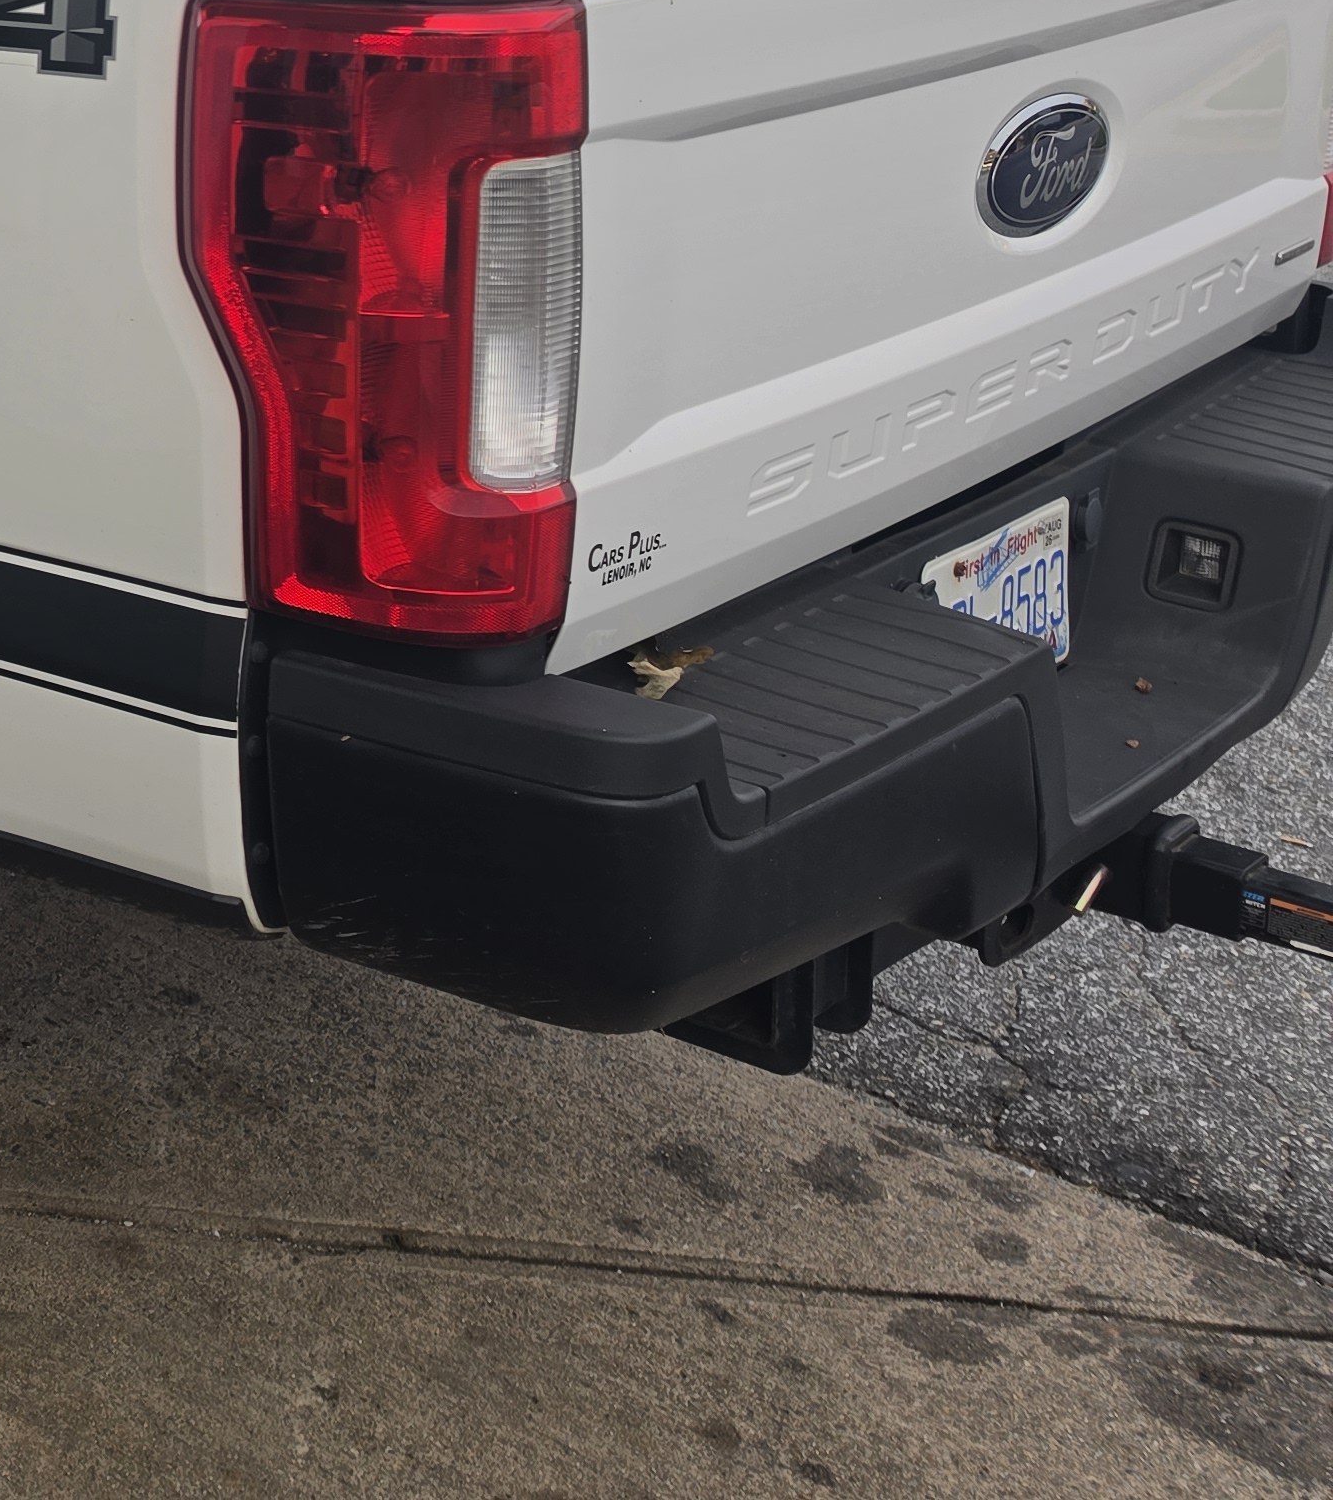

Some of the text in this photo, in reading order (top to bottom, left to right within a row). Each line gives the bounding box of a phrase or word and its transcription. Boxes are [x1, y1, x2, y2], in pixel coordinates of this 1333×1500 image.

[1019, 125, 1093, 210] Ford
[745, 247, 1261, 518] SUPER DUTY
[601, 556, 652, 587] LENOIR, NC
[952, 549, 1065, 637] -8583
[954, 553, 984, 582] irst
[1007, 525, 1038, 558] Flight
